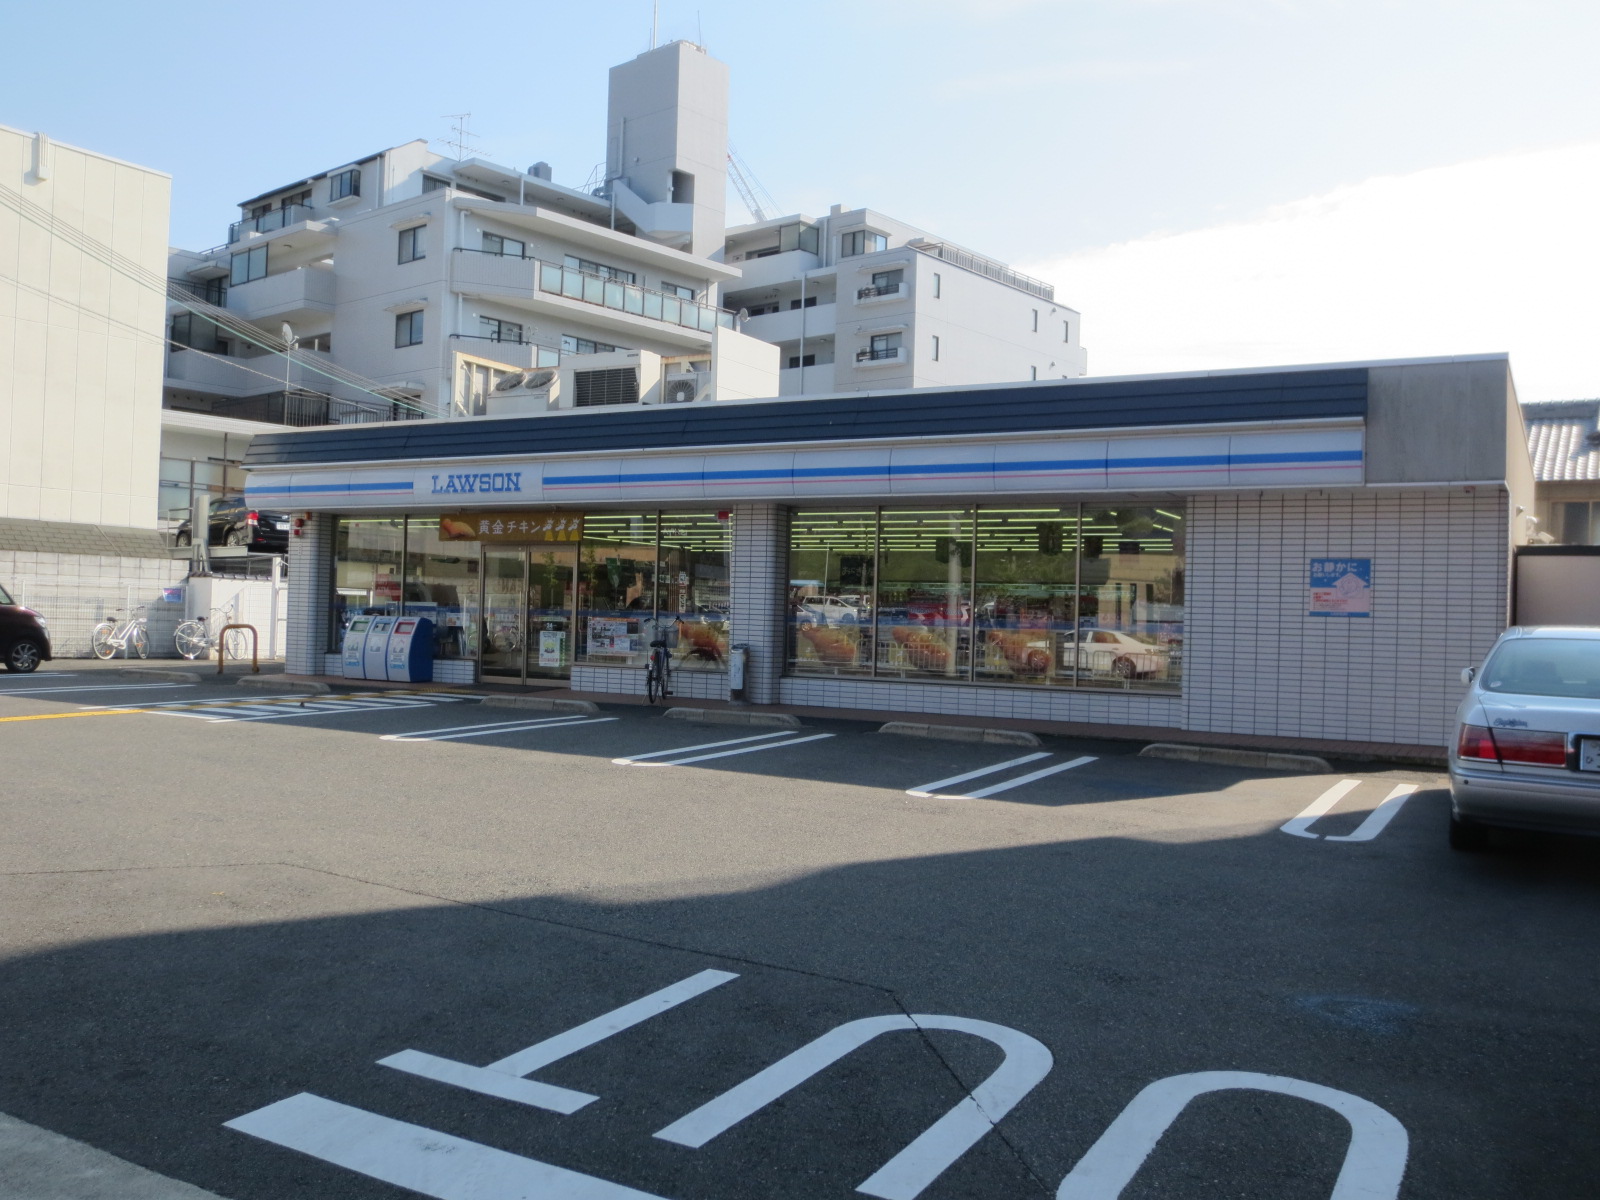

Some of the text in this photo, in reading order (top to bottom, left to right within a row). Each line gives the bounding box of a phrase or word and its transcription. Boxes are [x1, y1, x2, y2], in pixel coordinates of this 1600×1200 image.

[431, 472, 521, 494] LAWSON
[479, 519, 541, 535] 黄金チキン
[1312, 562, 1358, 572] お静かに
